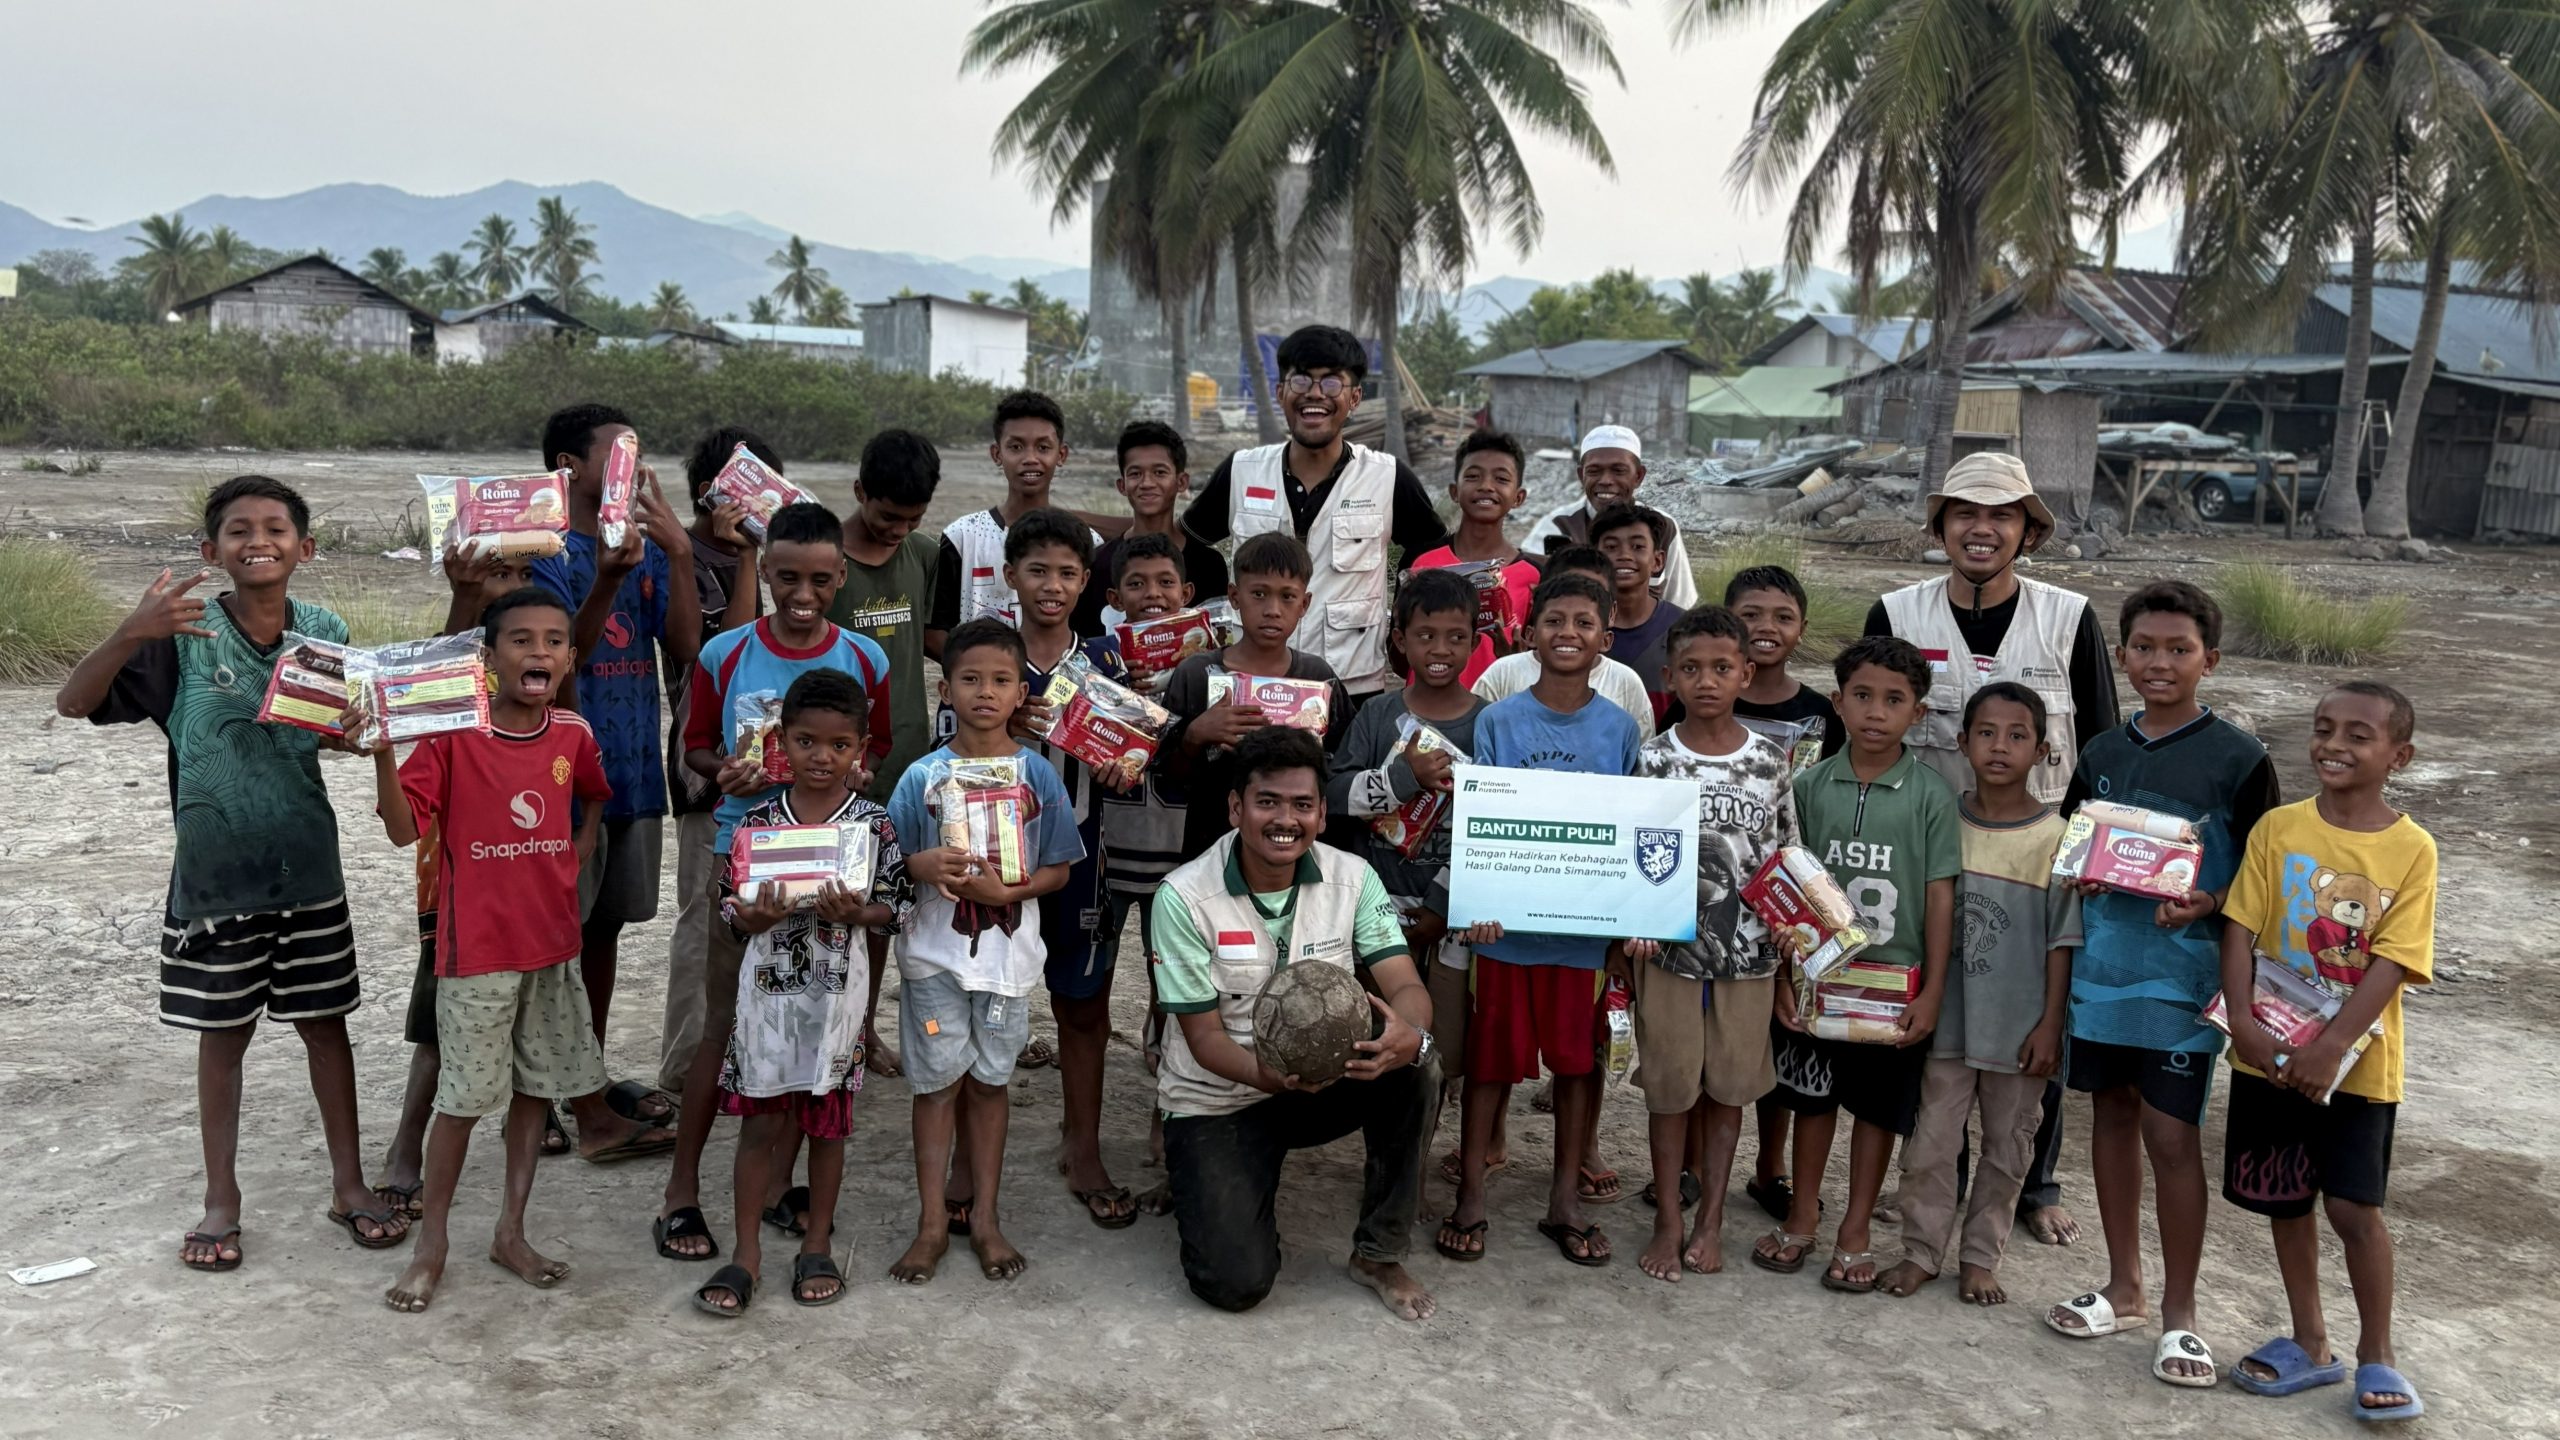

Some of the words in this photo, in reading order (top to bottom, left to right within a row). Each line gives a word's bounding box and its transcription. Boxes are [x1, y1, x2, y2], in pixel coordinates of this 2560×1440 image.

[738, 460, 763, 486] Roma
[482, 488, 521, 500] Roma
[854, 616, 871, 628] LEVI
[1144, 631, 1175, 645] Roma
[1262, 688, 1294, 702] Roma
[1092, 720, 1124, 745] Roma
[1478, 787, 1518, 795] nusantara
[1480, 780, 1511, 788] relawan
[1410, 790, 1434, 821] Roma
[1469, 821, 1527, 837] BANTU
[1530, 824, 1563, 839] NTT
[1567, 826, 1614, 842] PULIH
[1465, 847, 1506, 860] Dengan
[1508, 850, 1557, 862] Hadirkan
[1559, 852, 1628, 866] Kebahagiaan
[1824, 839, 1893, 872] ASH
[2117, 842, 2157, 861] Roma
[1465, 860, 1492, 871] Hasil
[1494, 862, 1531, 875] Galang
[1534, 864, 1561, 875] Dana
[1564, 866, 1627, 879] Simamaung
[1771, 882, 1799, 915] Roma
[1527, 911, 1618, 924] www.relawannusantara.org
[1846, 875, 1899, 946] 8
